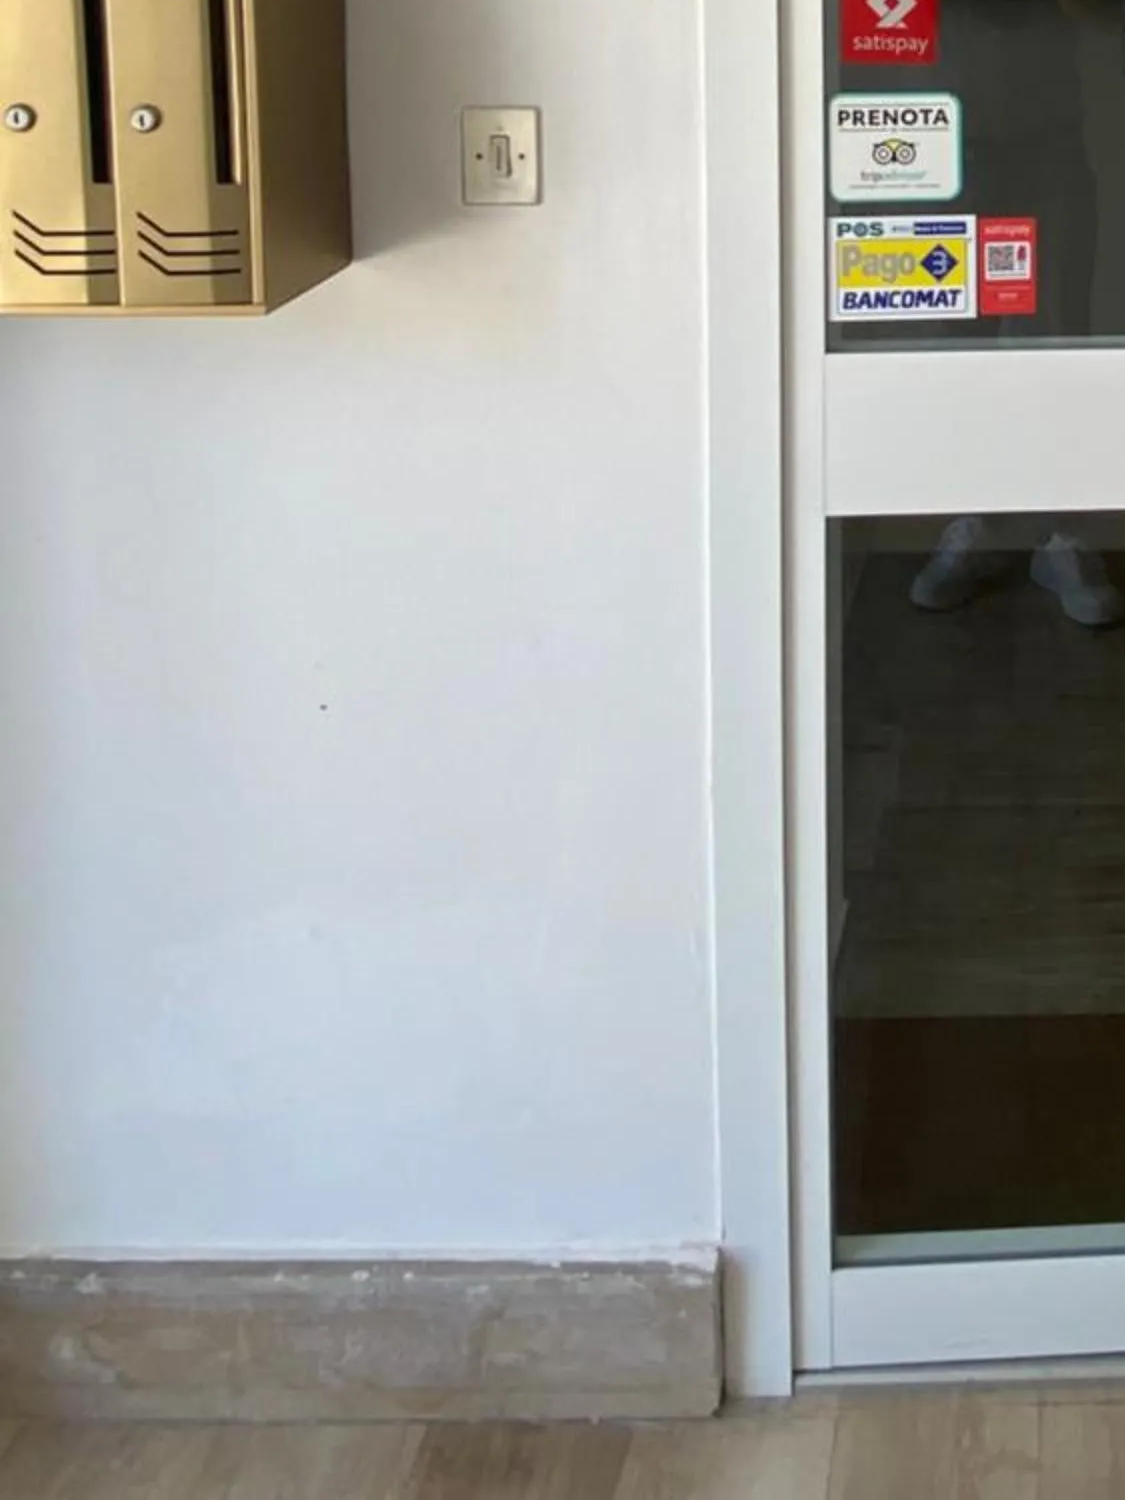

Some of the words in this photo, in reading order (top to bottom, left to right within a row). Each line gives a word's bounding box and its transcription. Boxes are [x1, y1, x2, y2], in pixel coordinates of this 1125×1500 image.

[853, 34, 929, 56] satispay
[837, 107, 950, 127] PRENOTA
[836, 221, 885, 238] POS
[839, 244, 916, 284] Pago
[842, 289, 962, 310] BANCOMAT
